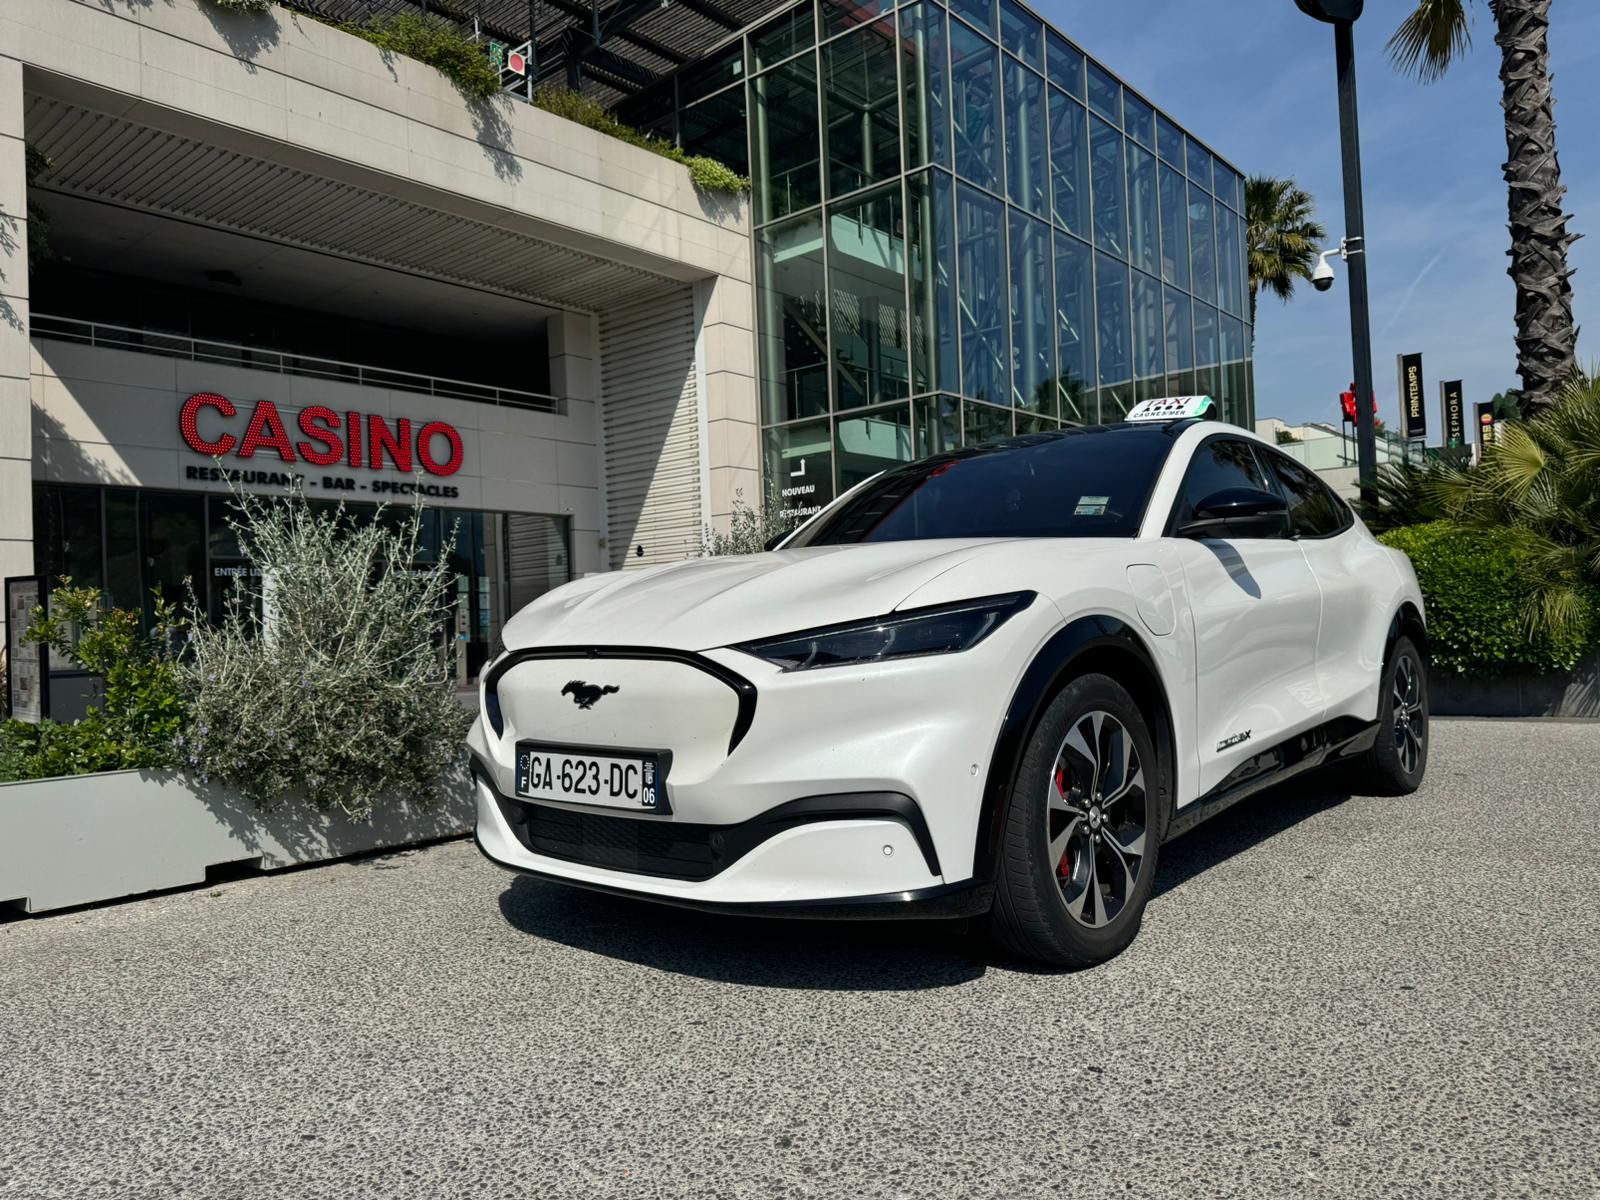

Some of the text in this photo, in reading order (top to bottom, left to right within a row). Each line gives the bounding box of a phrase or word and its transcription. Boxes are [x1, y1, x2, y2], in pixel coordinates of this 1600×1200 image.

[1147, 397, 1192, 407] TAXI
[1408, 365, 1420, 418] PRINTEMPS
[1449, 391, 1460, 438] SEPHORA
[179, 392, 464, 477] CASINO
[322, 476, 356, 491] BAR
[372, 480, 459, 498] SPECTACLES
[781, 485, 815, 497] NOUVEAU
[520, 776, 528, 788] F
[530, 756, 638, 799] GA-623-DC
[643, 787, 655, 804] 06
